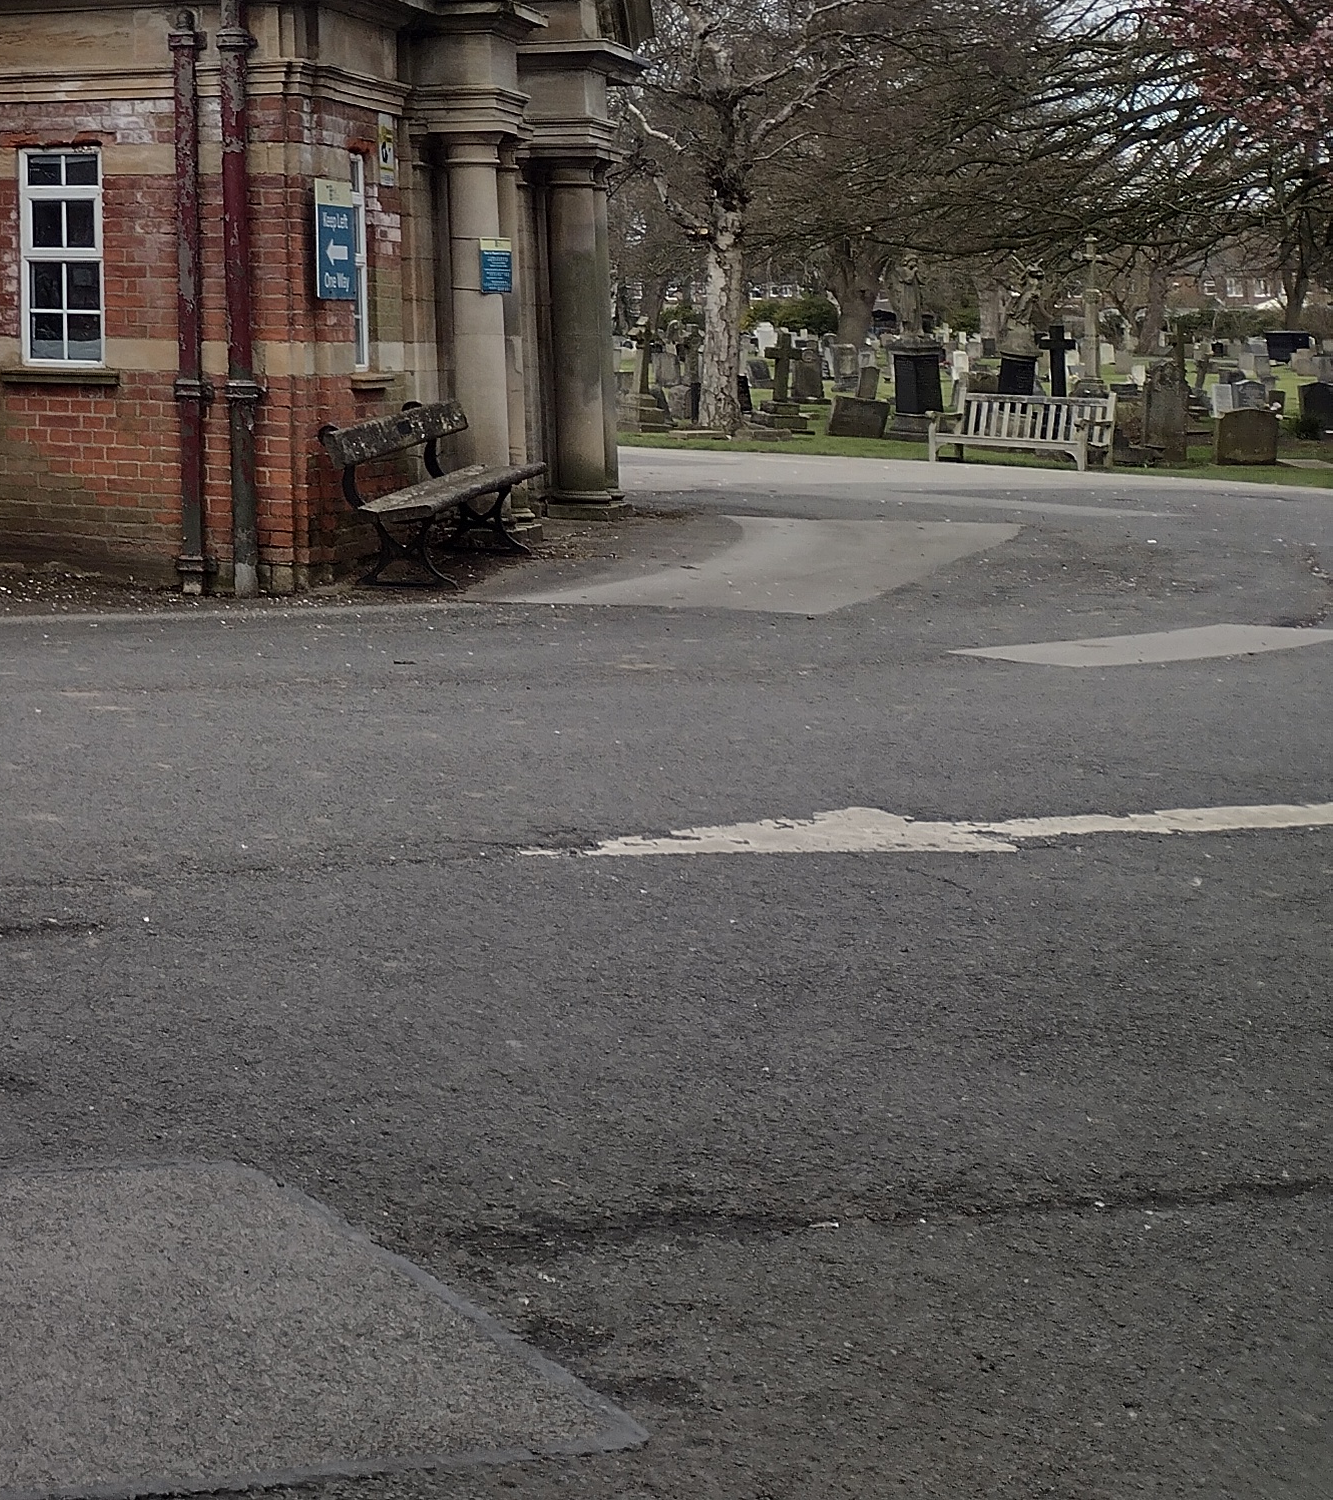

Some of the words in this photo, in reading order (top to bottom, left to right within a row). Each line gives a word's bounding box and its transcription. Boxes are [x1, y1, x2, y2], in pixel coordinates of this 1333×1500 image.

[323, 211, 336, 232] Keep
[336, 213, 349, 229] Left
[324, 271, 337, 288] One
[337, 272, 350, 292] Way
